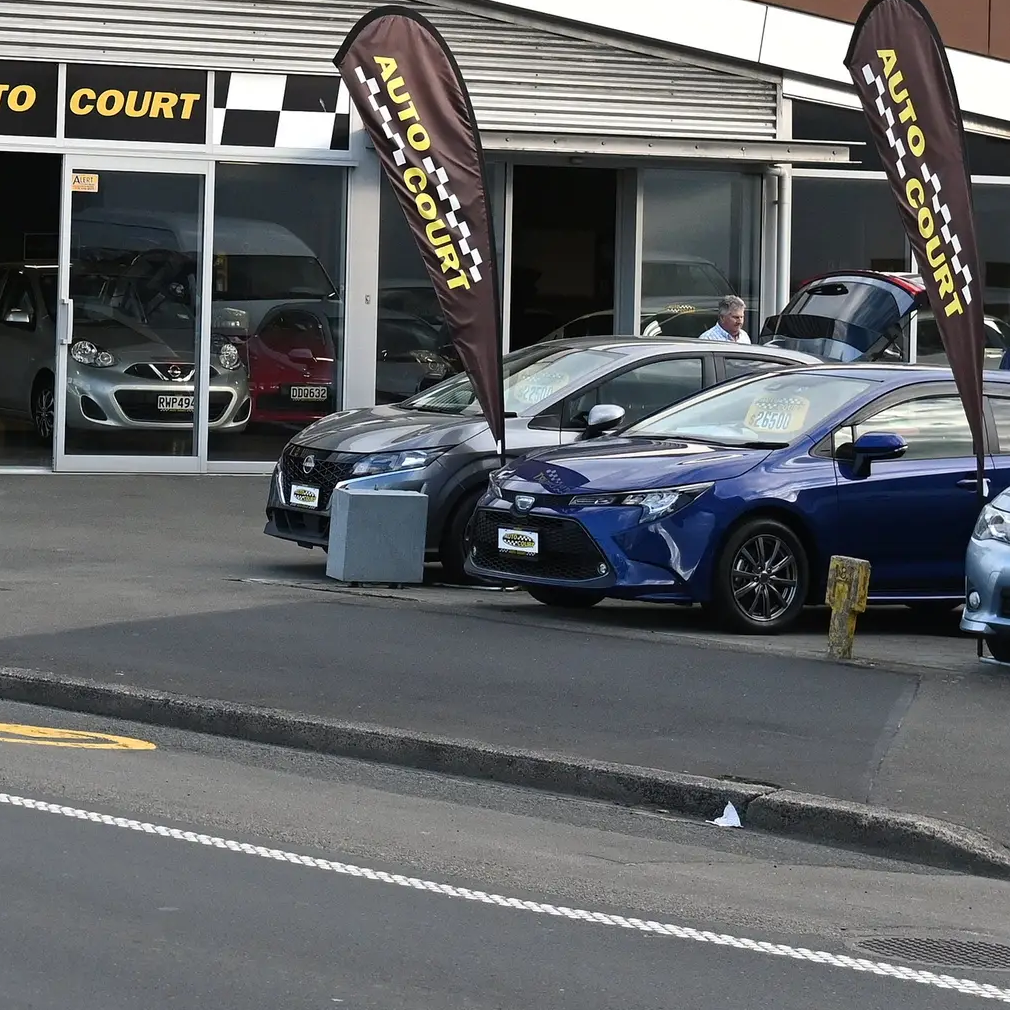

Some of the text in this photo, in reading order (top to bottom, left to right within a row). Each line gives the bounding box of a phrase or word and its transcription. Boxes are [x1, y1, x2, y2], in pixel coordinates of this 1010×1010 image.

[69, 88, 201, 120] COURT
[373, 55, 470, 290] AUTO COURT
[876, 48, 964, 318] AUTO COURT
[292, 387, 326, 399] DDQ632
